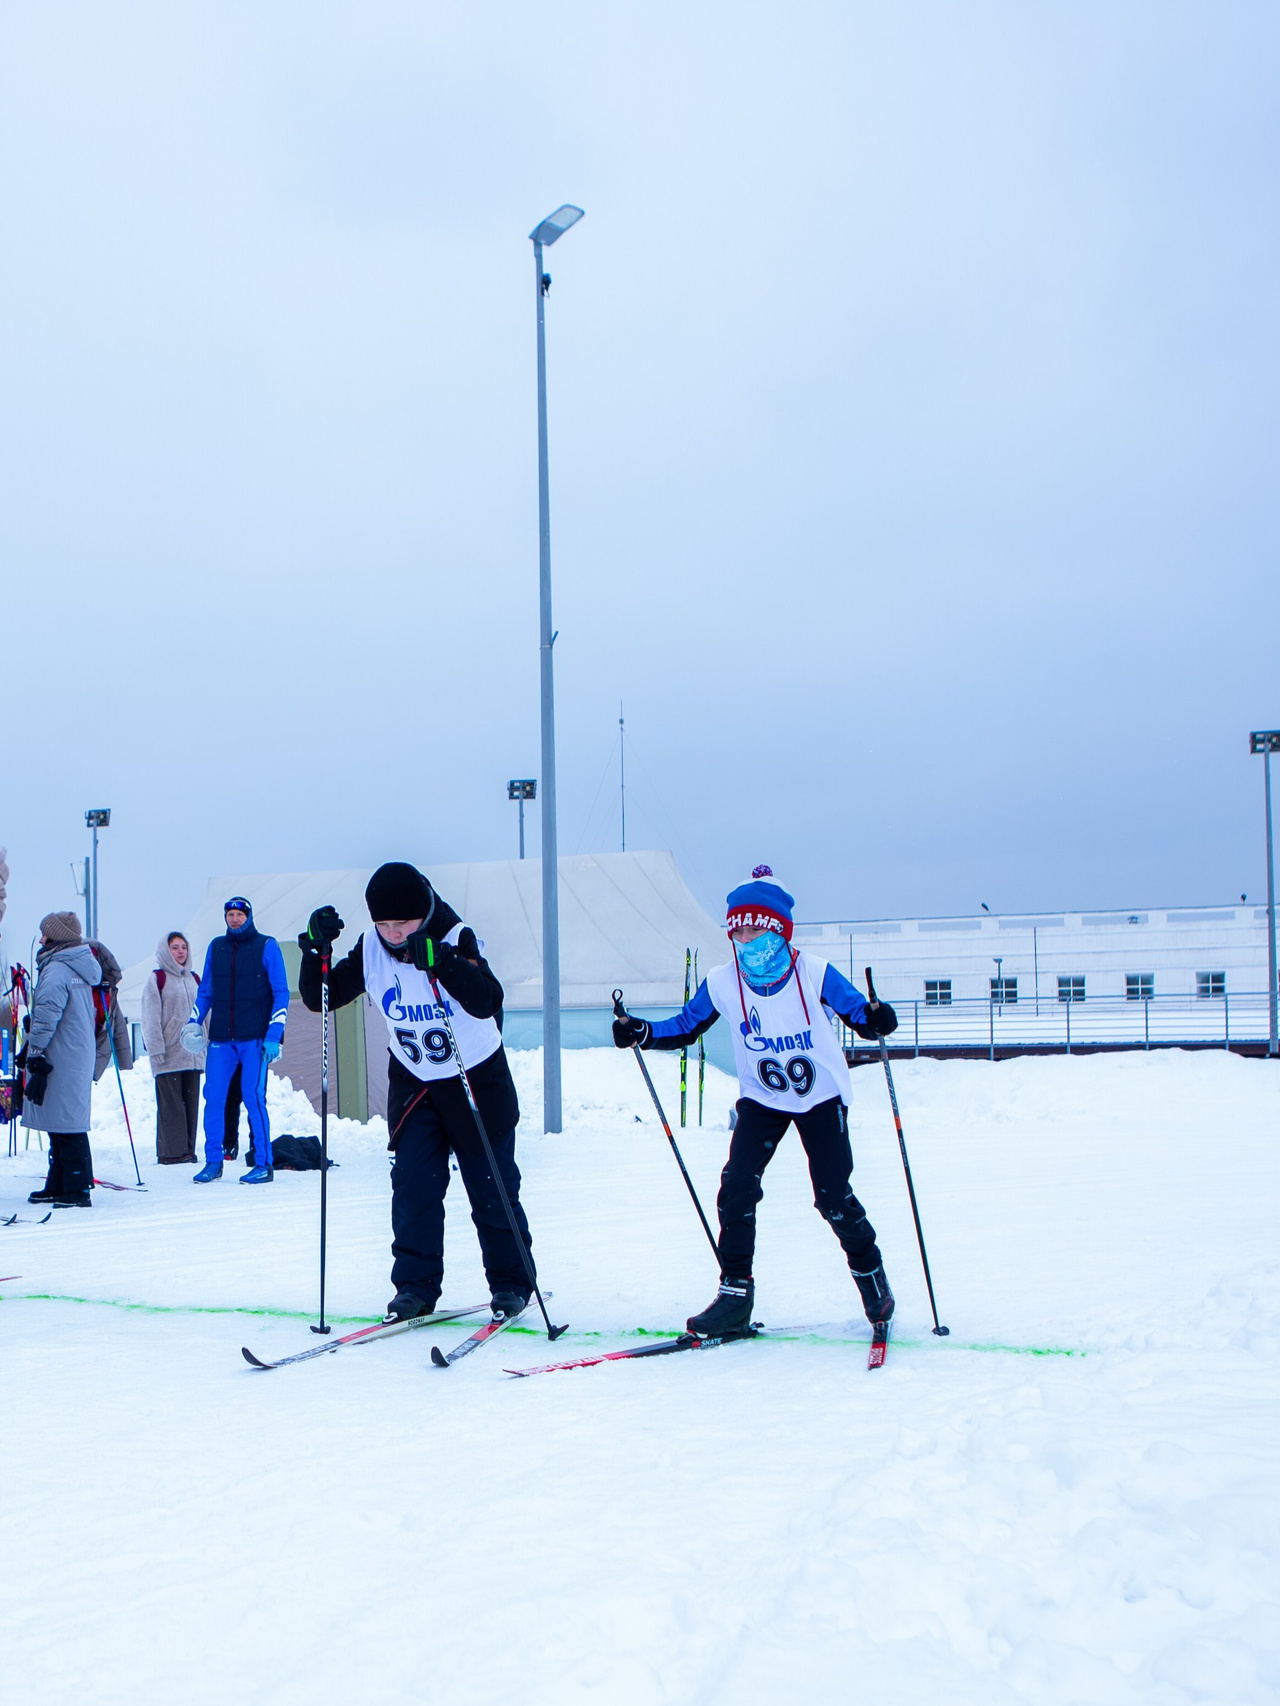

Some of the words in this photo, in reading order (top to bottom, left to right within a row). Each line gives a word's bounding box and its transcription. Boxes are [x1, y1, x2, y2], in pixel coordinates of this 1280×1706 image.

[393, 1026, 455, 1066] 59
[757, 1055, 817, 1098] 69
[701, 1337, 723, 1347] SKATE
